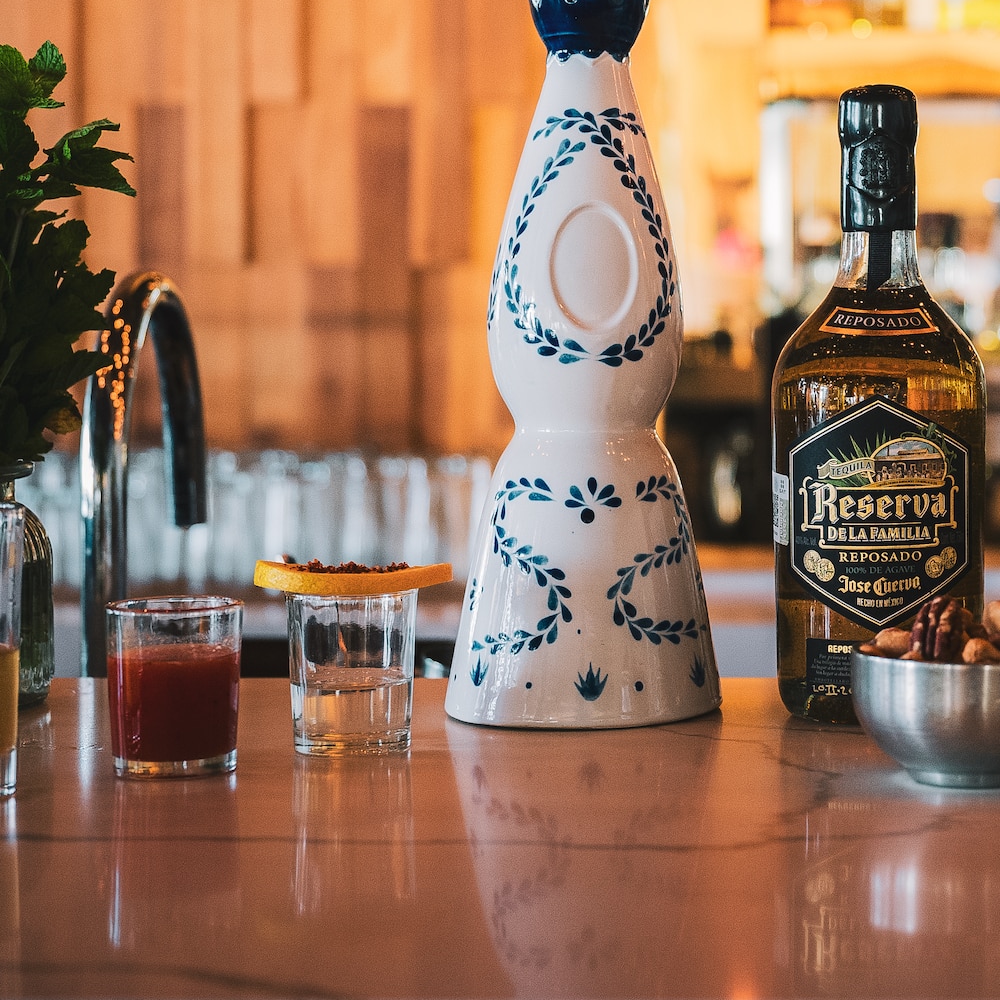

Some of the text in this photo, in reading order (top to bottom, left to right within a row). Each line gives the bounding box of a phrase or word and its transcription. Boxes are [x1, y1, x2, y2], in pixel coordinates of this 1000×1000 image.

[834, 313, 922, 328] REPOSADO
[830, 462, 872, 476] TEQUILA
[808, 482, 948, 524] Reserva
[827, 526, 848, 542] DE
[848, 526, 868, 542] LA
[870, 525, 932, 542] FAMILIA
[838, 551, 922, 563] REPOSADO
[885, 565, 916, 574] AGAVE
[838, 574, 872, 594] Jose
[856, 596, 904, 608] HECHO EN MÉXICO
